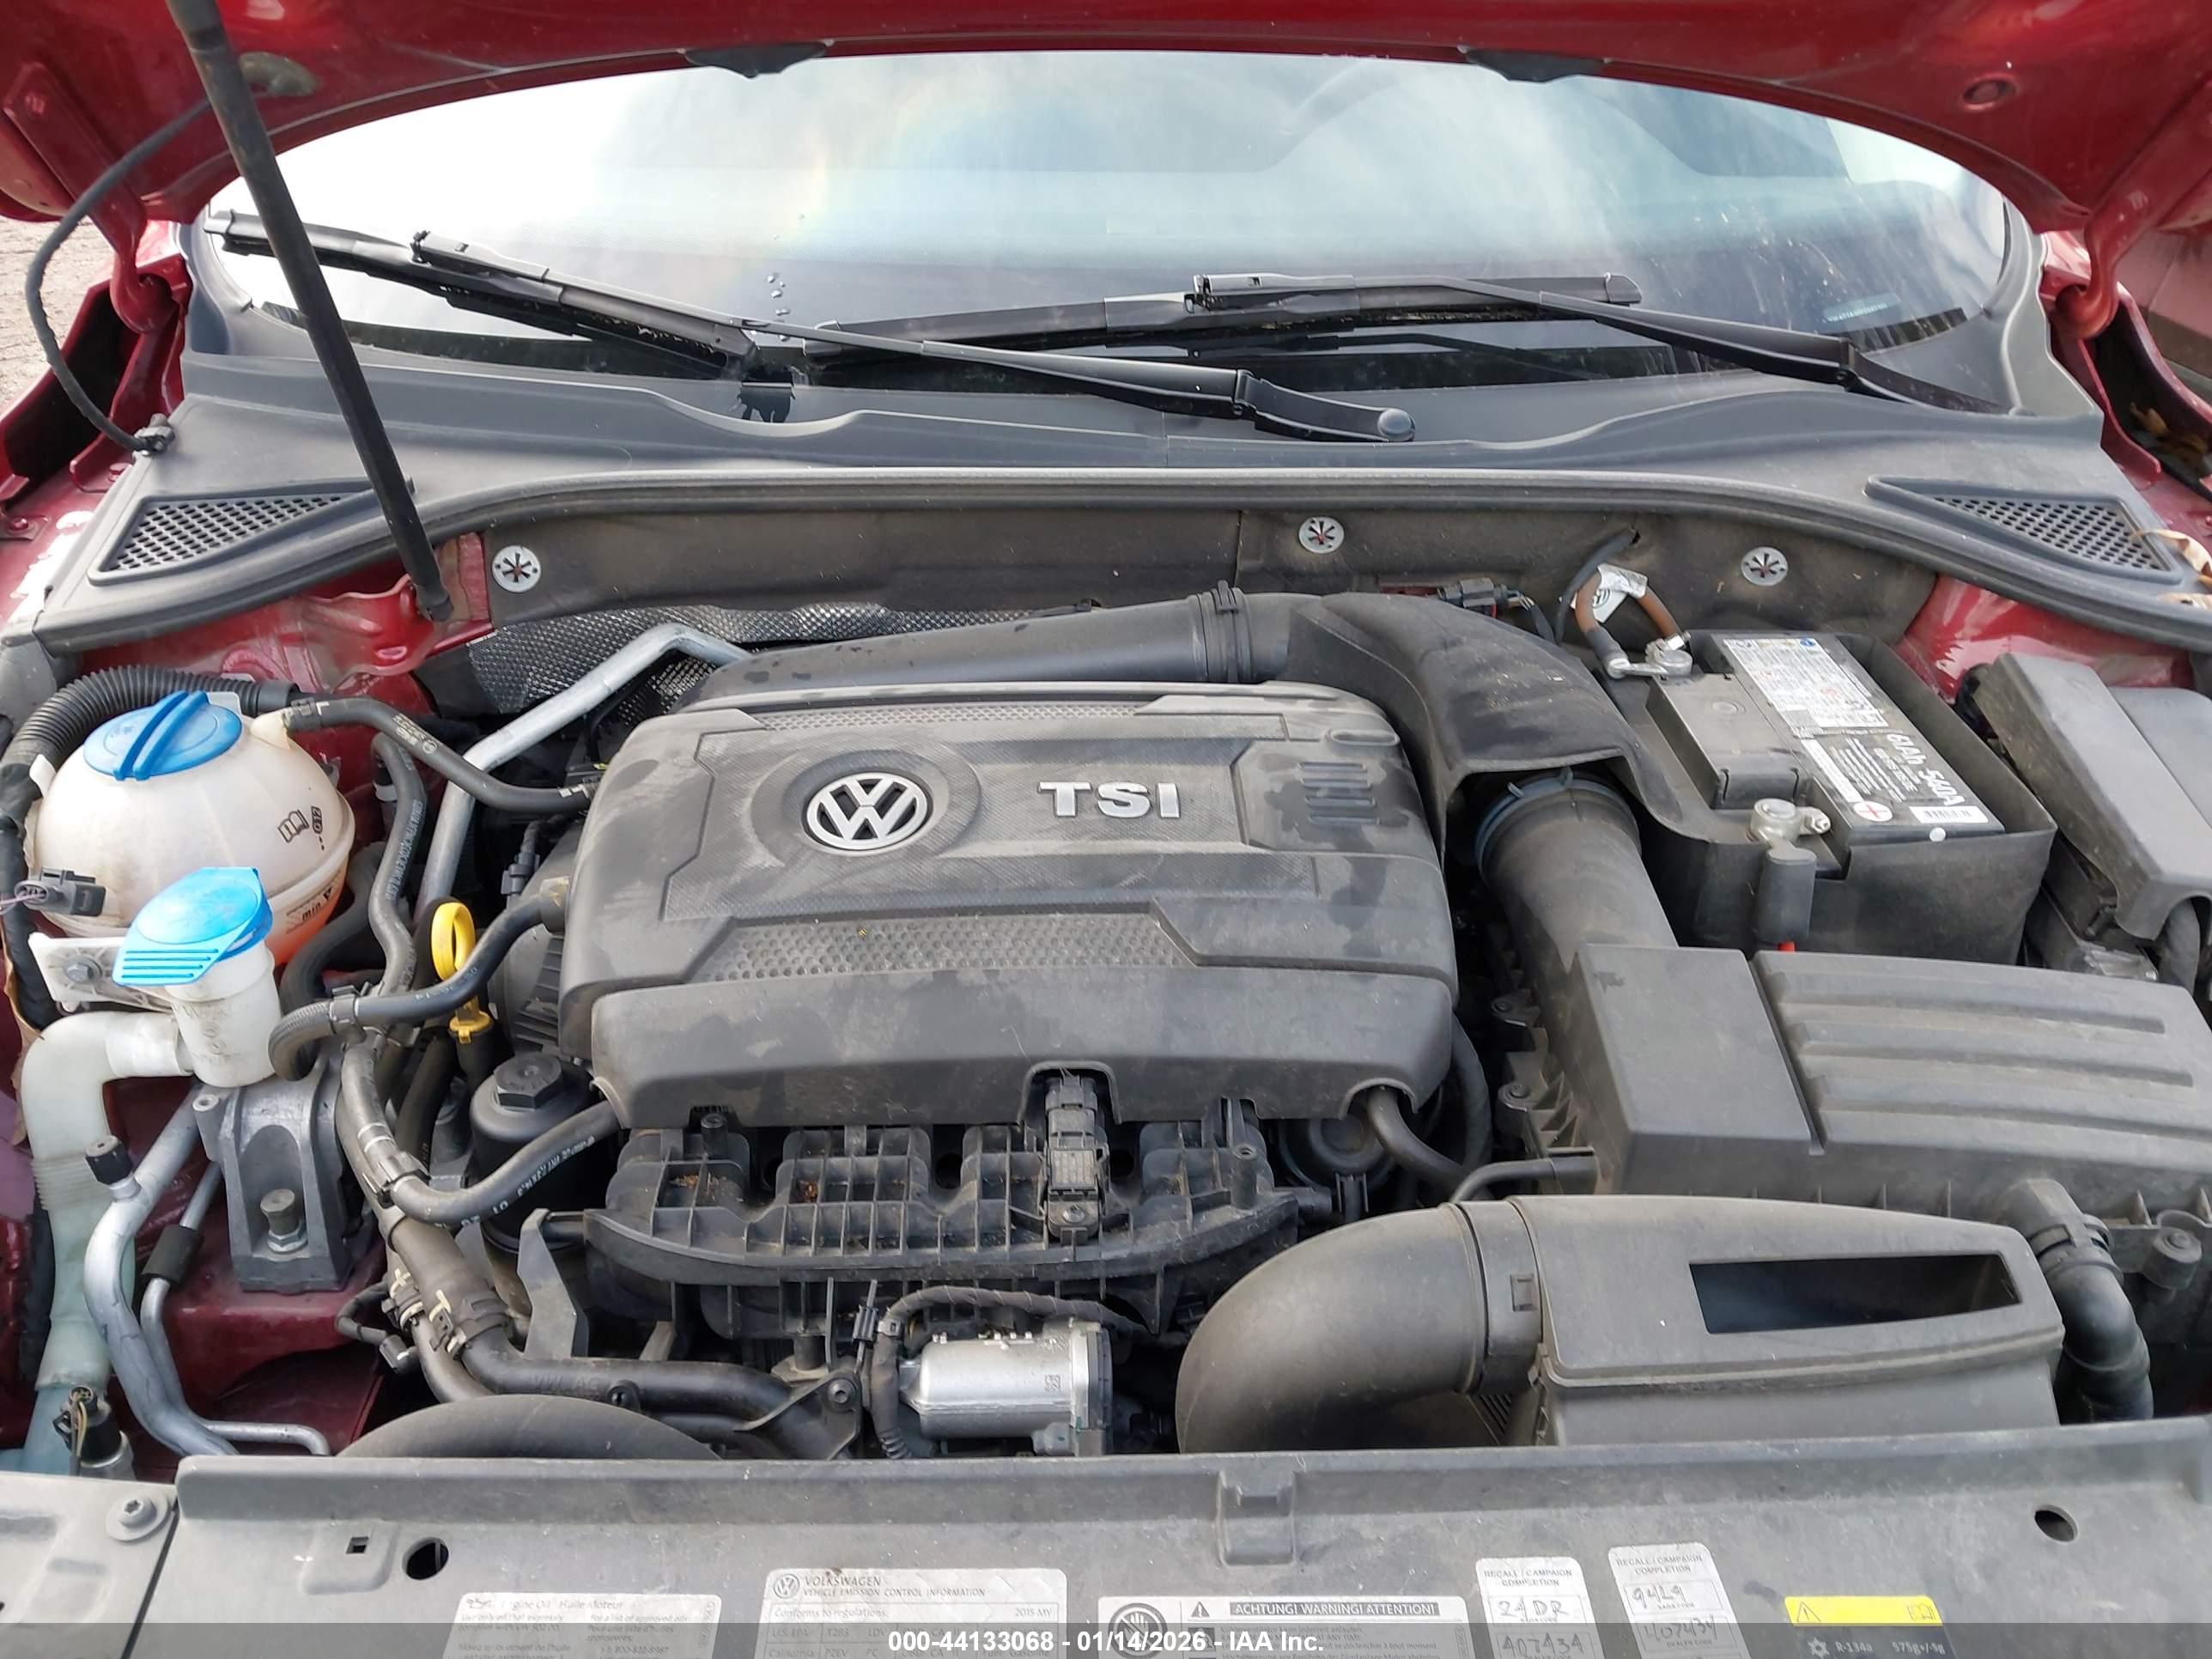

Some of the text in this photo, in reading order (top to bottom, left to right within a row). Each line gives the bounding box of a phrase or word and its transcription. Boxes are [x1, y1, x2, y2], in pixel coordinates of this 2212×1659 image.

[1038, 781, 1181, 818] TSI
[301, 902, 322, 922] min
[1616, 1558, 1650, 1567] RECALL
[1657, 1553, 1703, 1565] CAMPAIGN
[1526, 1568, 1572, 1577] CAMPAIGN
[1635, 1564, 1692, 1575] COMPLETION
[804, 1576, 881, 1587] VOLKSWAGEN
[1500, 1578, 1560, 1587] COMPLETION
[927, 1588, 985, 1596] INFORMATION
[774, 1607, 819, 1618] Conforms
[1235, 1602, 1435, 1615] ACHTUNG! WARNING! ATTENTION!
